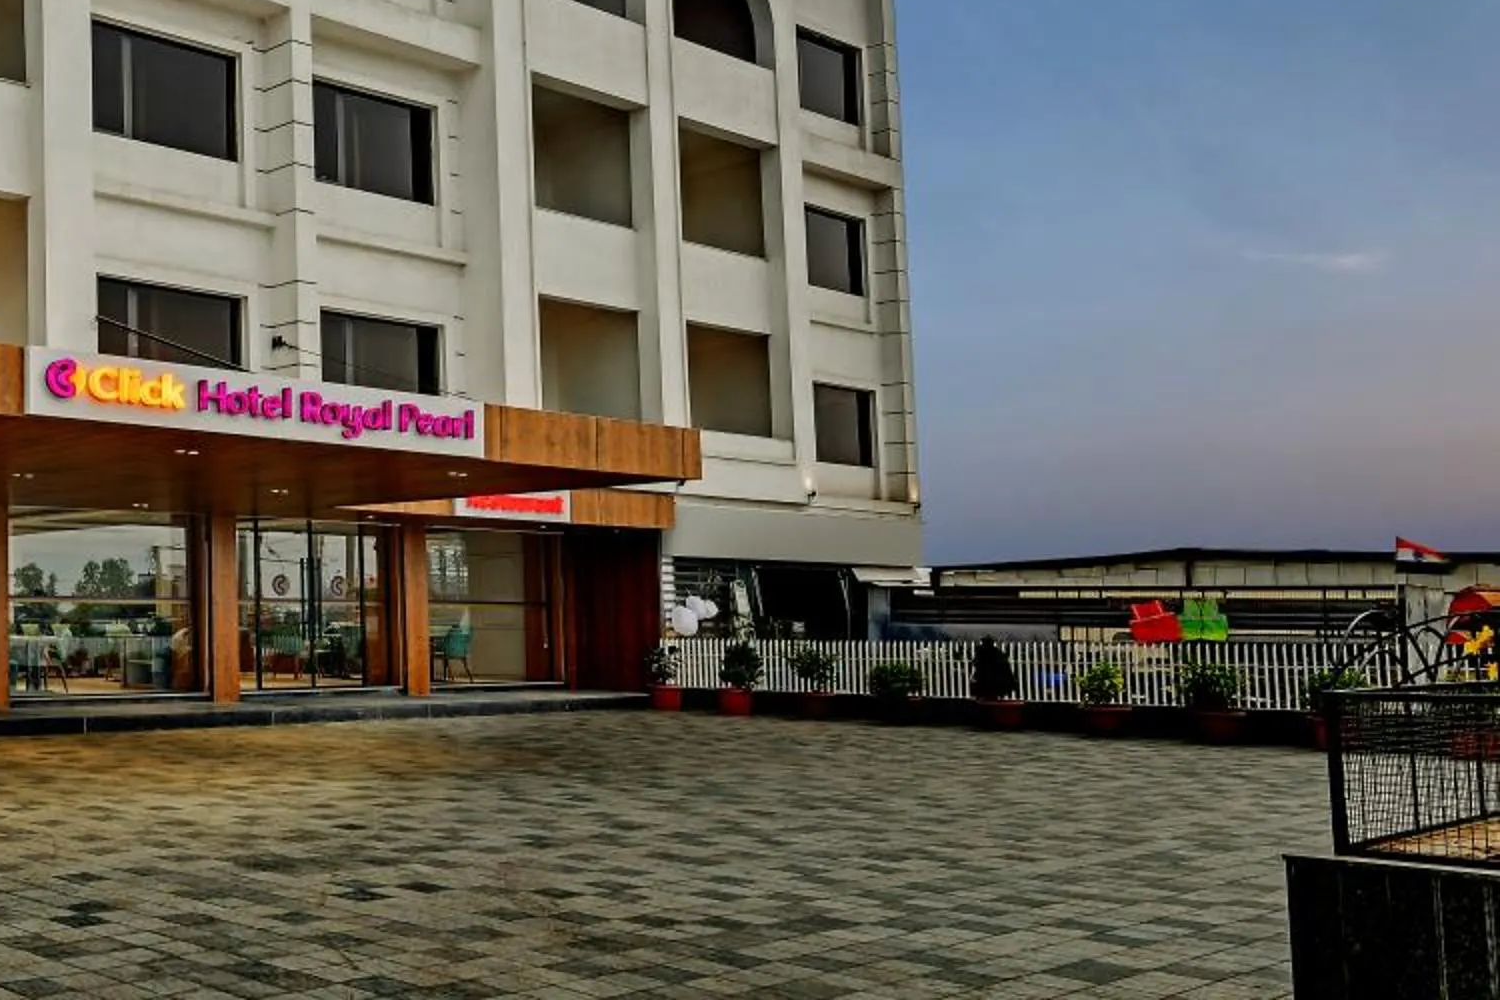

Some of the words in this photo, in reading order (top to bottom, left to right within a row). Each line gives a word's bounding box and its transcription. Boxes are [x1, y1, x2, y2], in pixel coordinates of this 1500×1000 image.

[88, 367, 186, 410] Click
[196, 379, 293, 419] Hotel
[299, 390, 393, 439] Royal
[398, 403, 475, 440] Pearl
